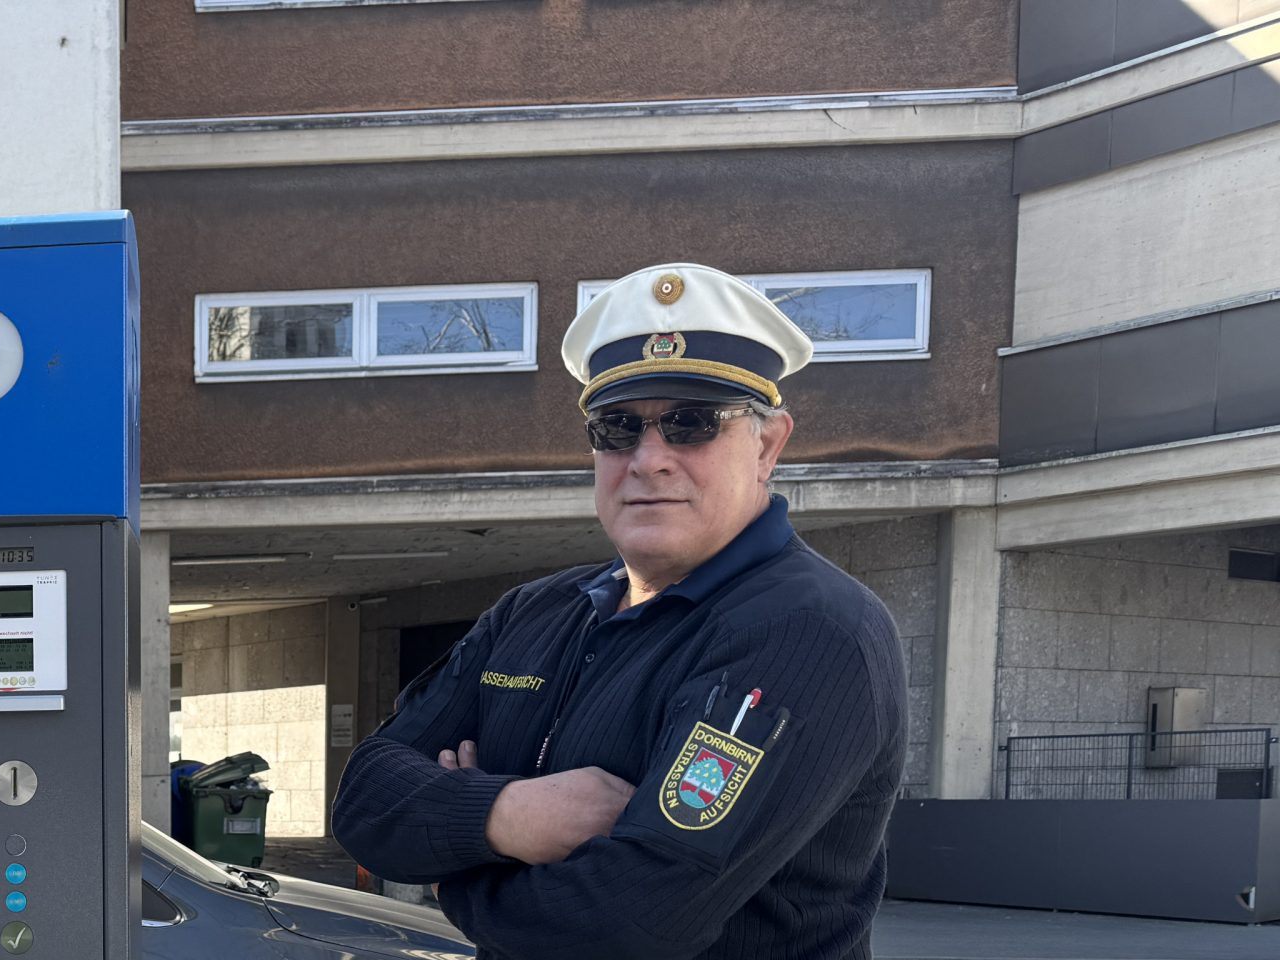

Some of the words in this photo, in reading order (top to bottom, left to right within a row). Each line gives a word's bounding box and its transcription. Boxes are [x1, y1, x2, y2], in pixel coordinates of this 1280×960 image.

[2, 550, 32, 563] 10:35
[695, 729, 757, 765] DORNBIRN
[666, 742, 699, 808] STRASSEN
[700, 765, 748, 822] AUFSICHT
